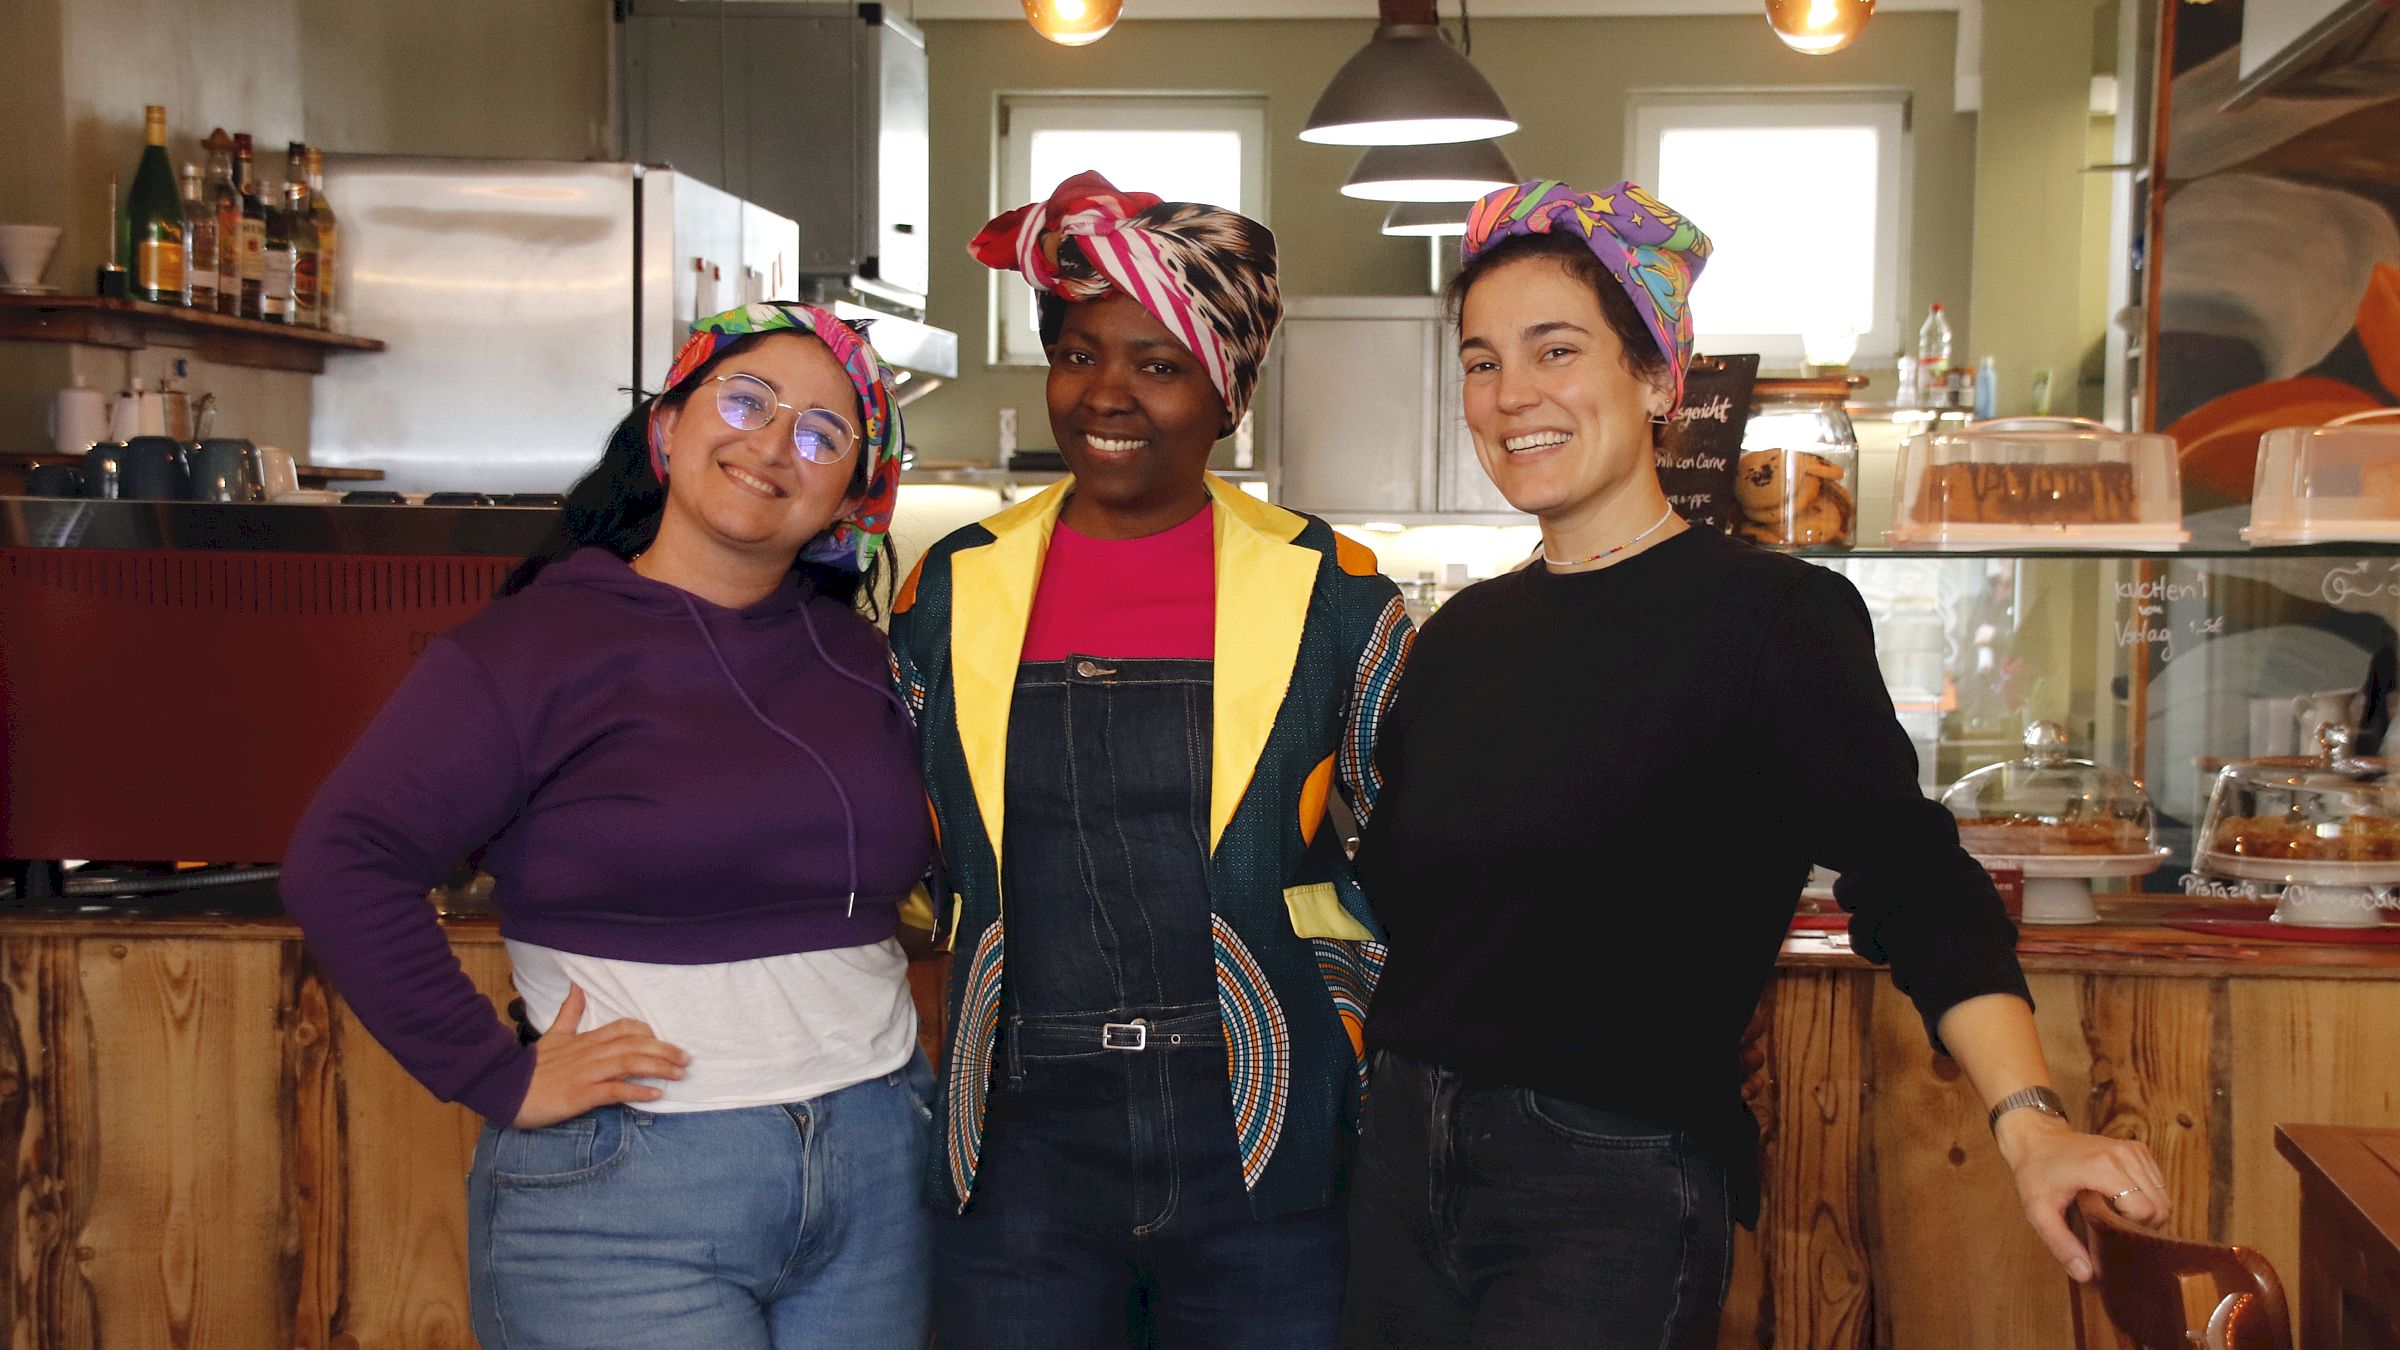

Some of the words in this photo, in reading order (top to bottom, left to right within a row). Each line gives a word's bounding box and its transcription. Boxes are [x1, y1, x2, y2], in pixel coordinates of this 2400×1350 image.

[1673, 395, 1732, 432] sgericht
[1655, 452, 1673, 468] hili
[1676, 457, 1694, 469] con
[1696, 452, 1727, 472] Carne
